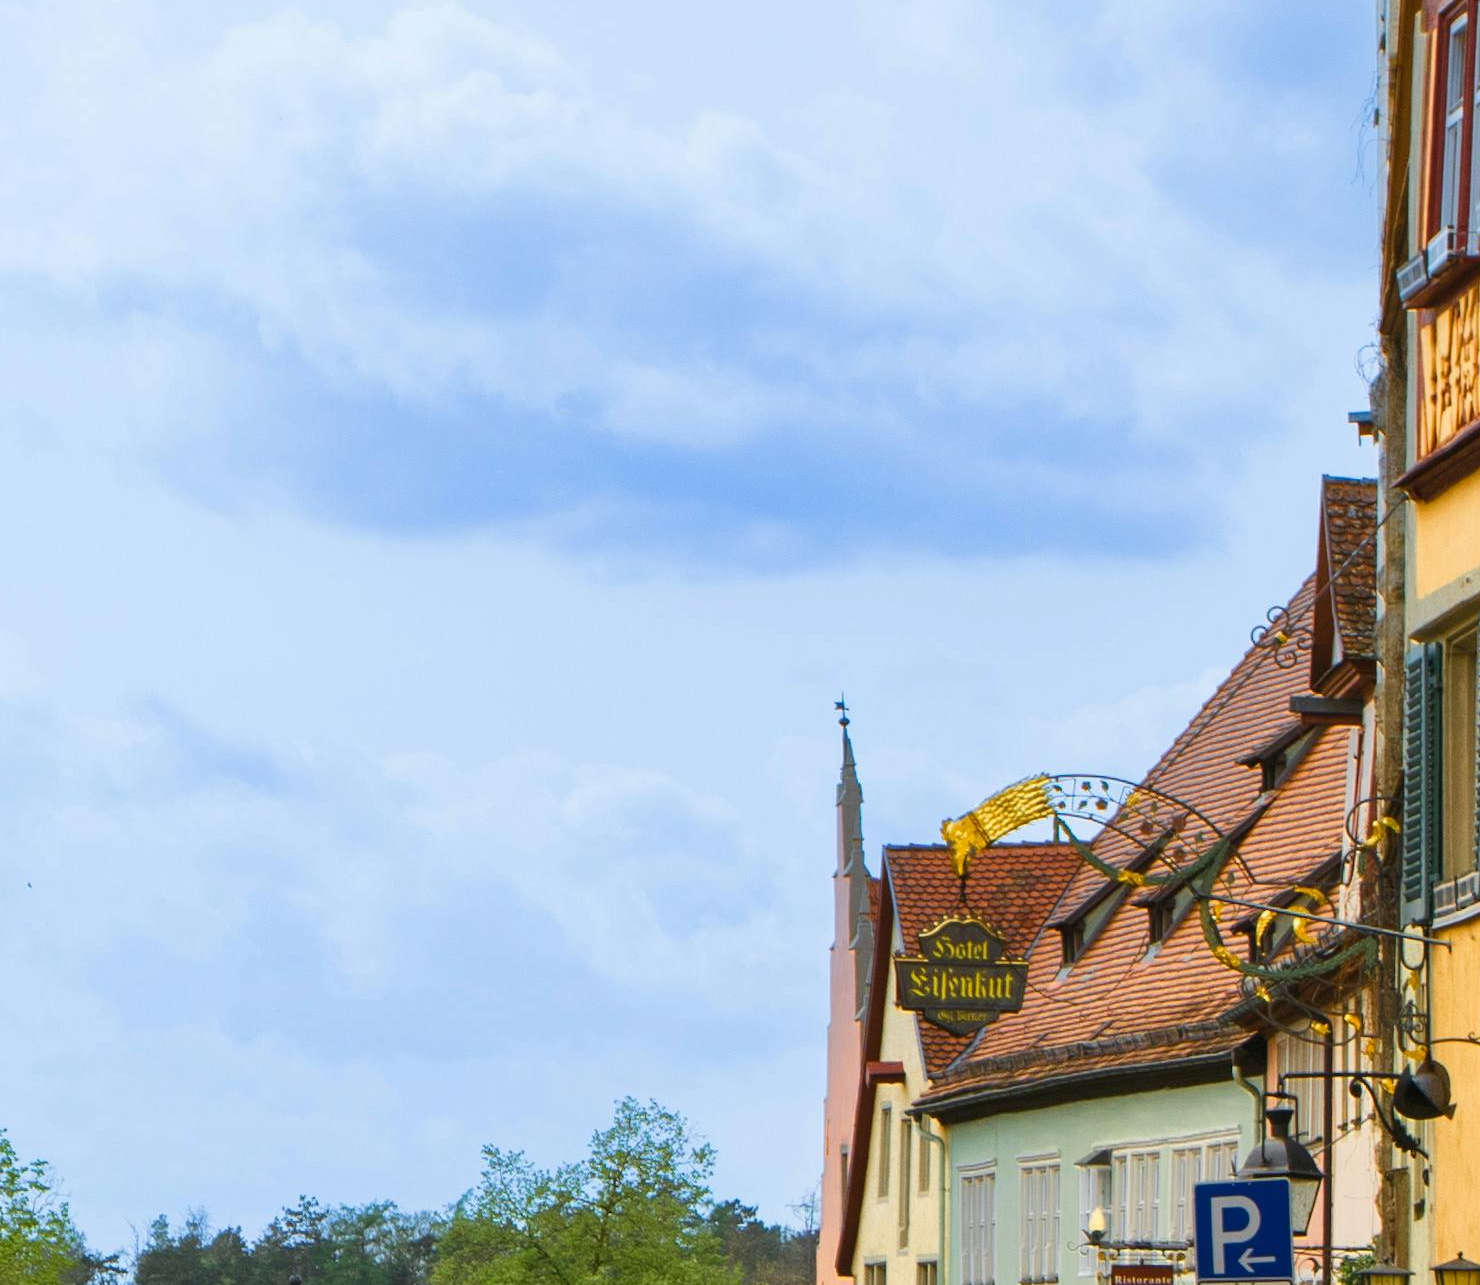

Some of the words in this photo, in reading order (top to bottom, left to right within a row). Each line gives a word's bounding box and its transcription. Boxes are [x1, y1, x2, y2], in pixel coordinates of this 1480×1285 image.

[933, 936, 989, 960] Hotel
[910, 967, 1014, 1001] Eisenhut
[1210, 1195, 1261, 1274] P
[1114, 1275, 1172, 1285] Ristorante
